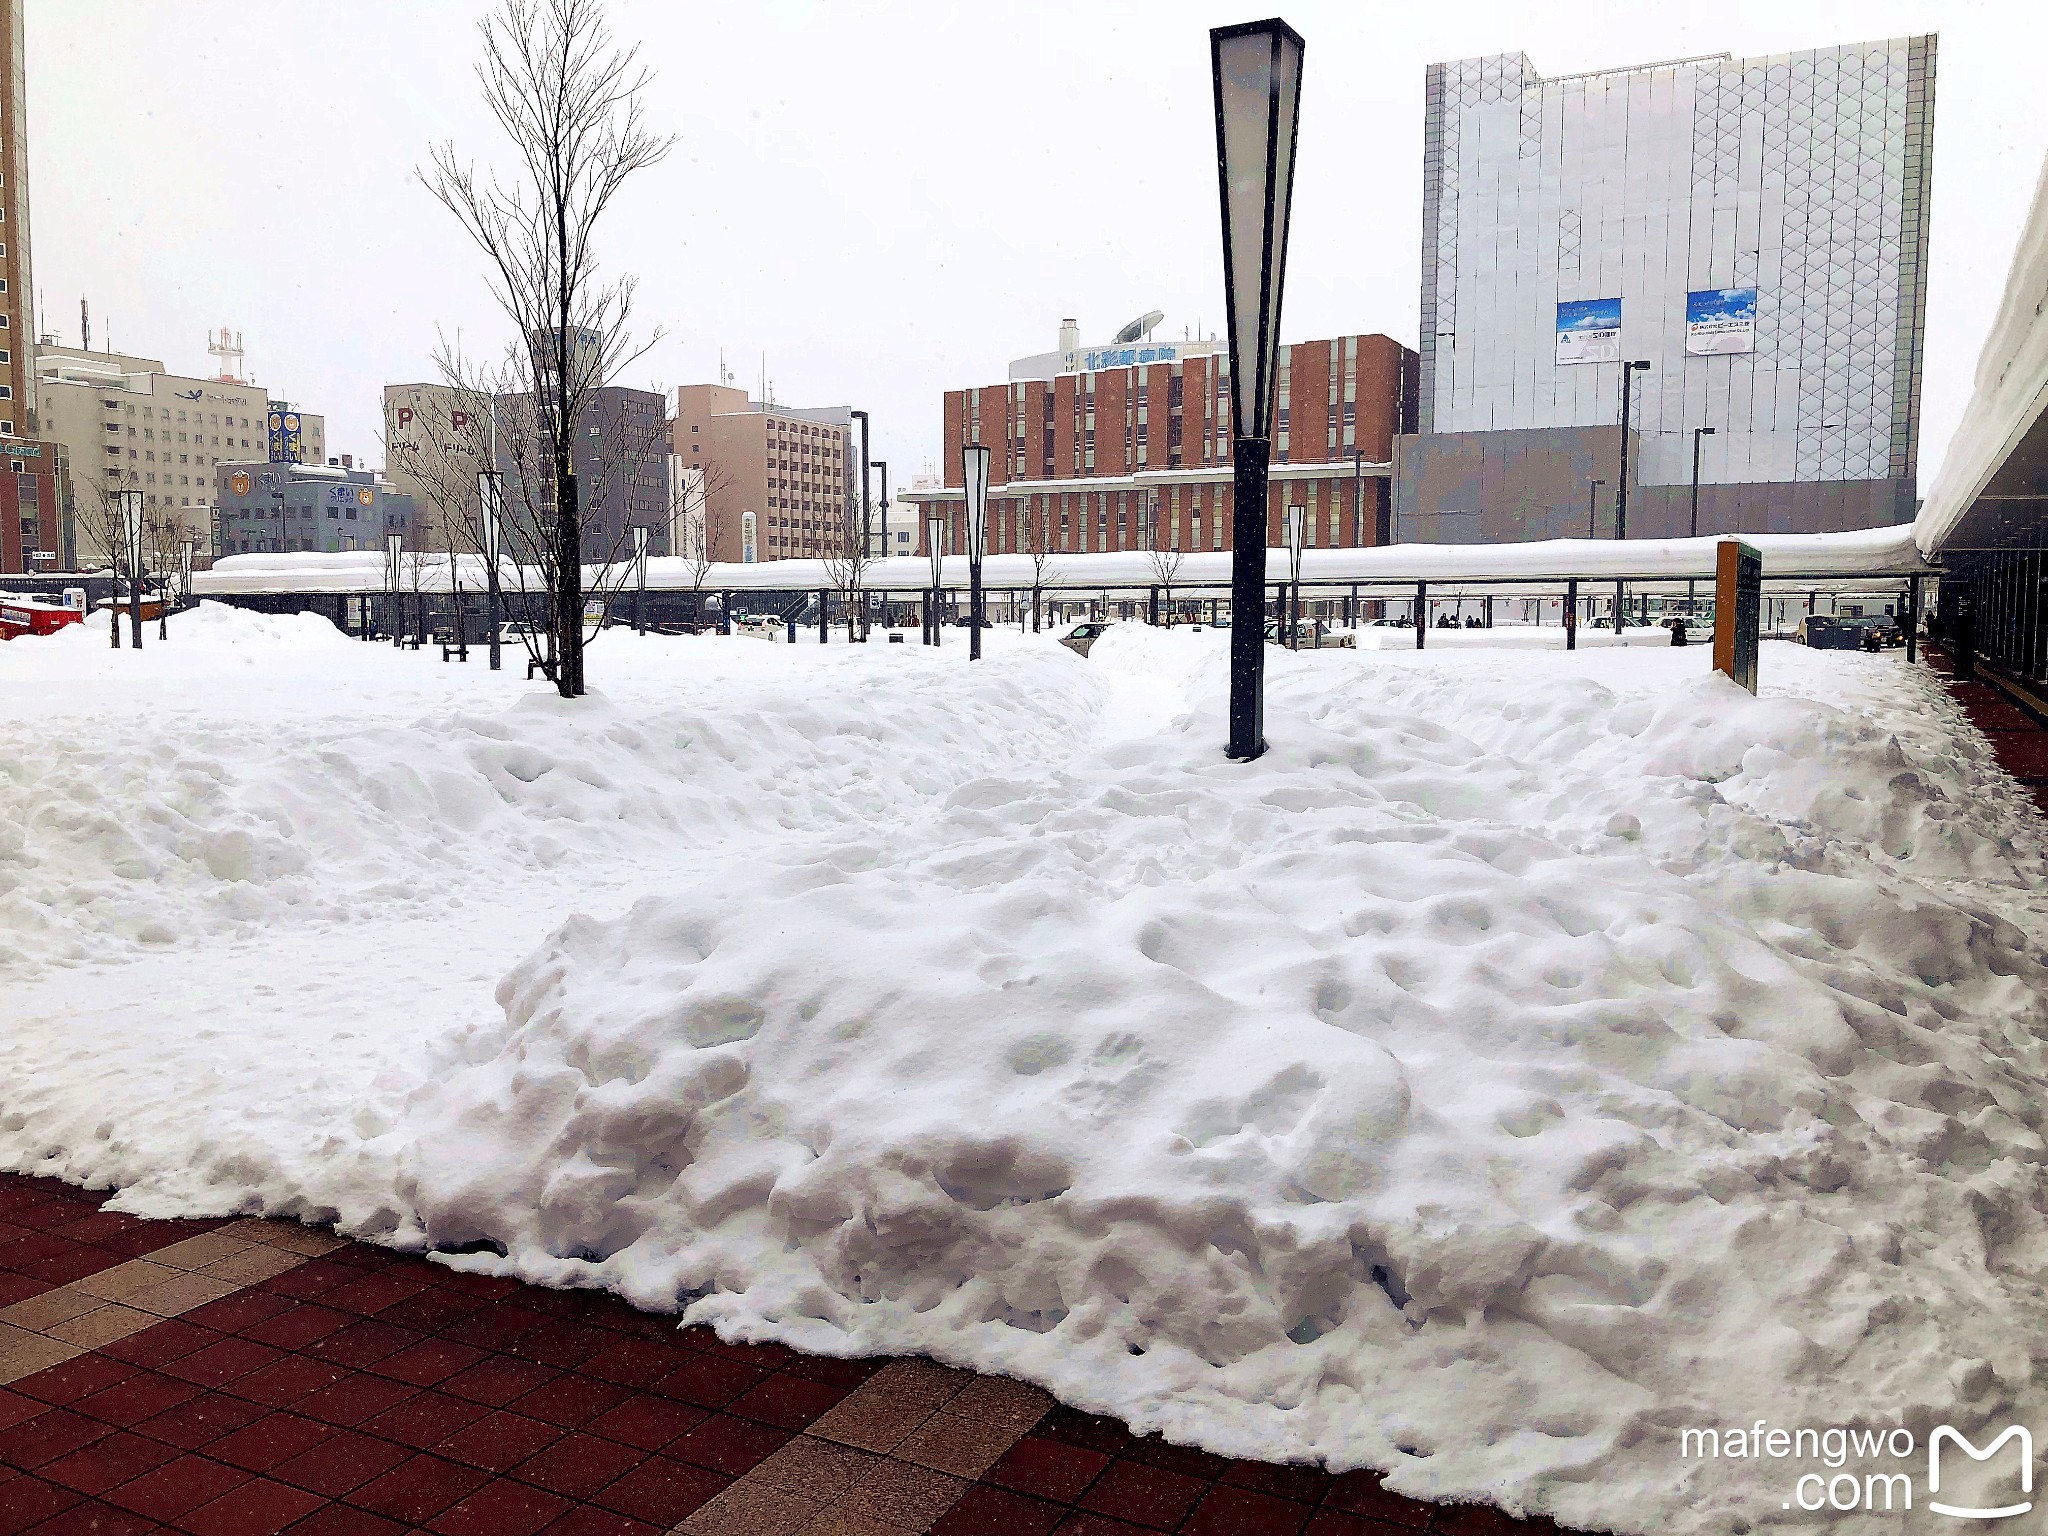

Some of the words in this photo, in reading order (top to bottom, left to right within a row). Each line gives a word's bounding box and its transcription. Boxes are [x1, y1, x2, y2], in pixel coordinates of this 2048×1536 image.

[1085, 346, 1176, 370] 北彩都病院
[398, 408, 413, 429] P
[452, 411, 468, 431] P
[329, 486, 354, 496] くまい
